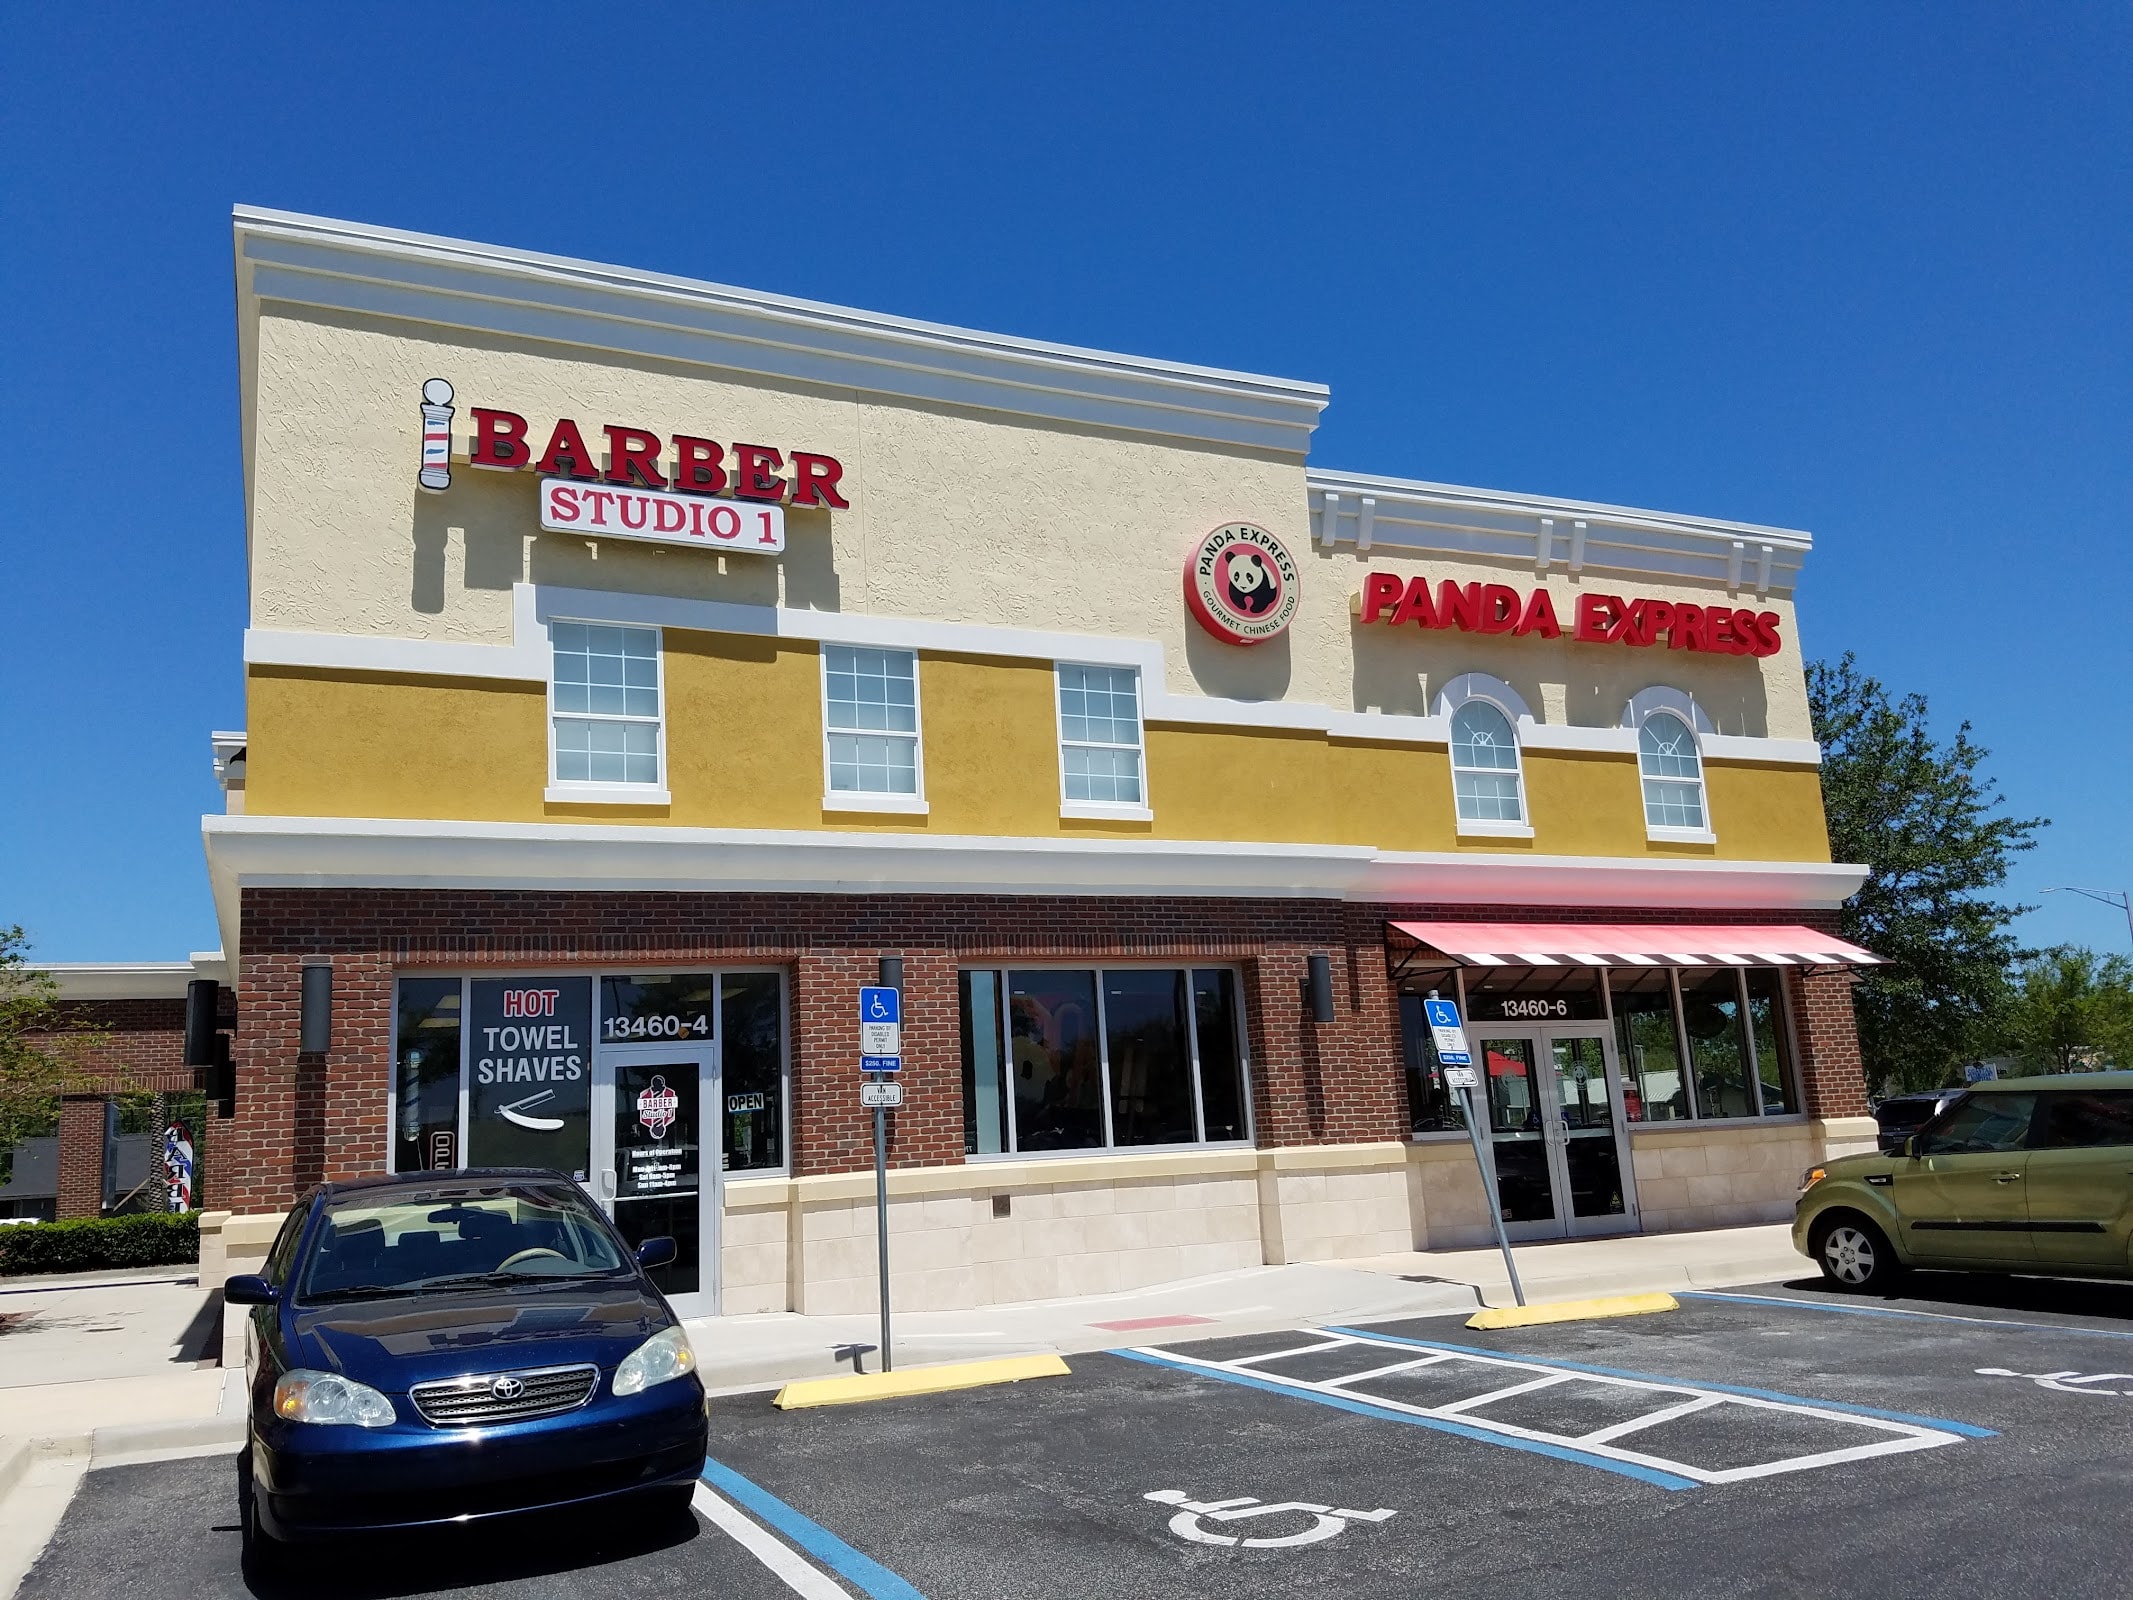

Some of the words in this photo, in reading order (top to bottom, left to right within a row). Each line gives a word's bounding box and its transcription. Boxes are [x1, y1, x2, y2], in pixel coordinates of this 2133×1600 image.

[470, 407, 849, 511] BARBER
[550, 487, 741, 540] STUDIO
[758, 511, 778, 546] 1
[1200, 529, 1235, 576] PANDA
[1240, 528, 1295, 582] EXPRESS
[1203, 590, 1241, 631] GOURMET
[1243, 620, 1281, 635] CHINESE
[1279, 596, 1295, 622] FOOD
[1360, 572, 1561, 639] PANDA
[1573, 593, 1781, 658] EXPRESS
[503, 989, 560, 1018] HOT
[1501, 999, 1568, 1017] 13460-6
[483, 1025, 578, 1052] TOWEL
[604, 1014, 709, 1038] 13460-4
[478, 1055, 581, 1084] SHAVES
[642, 1108, 667, 1118] Studio
[643, 1098, 673, 1109] BARBER
[729, 1093, 762, 1110] OPEN
[435, 1135, 450, 1170] OPE
